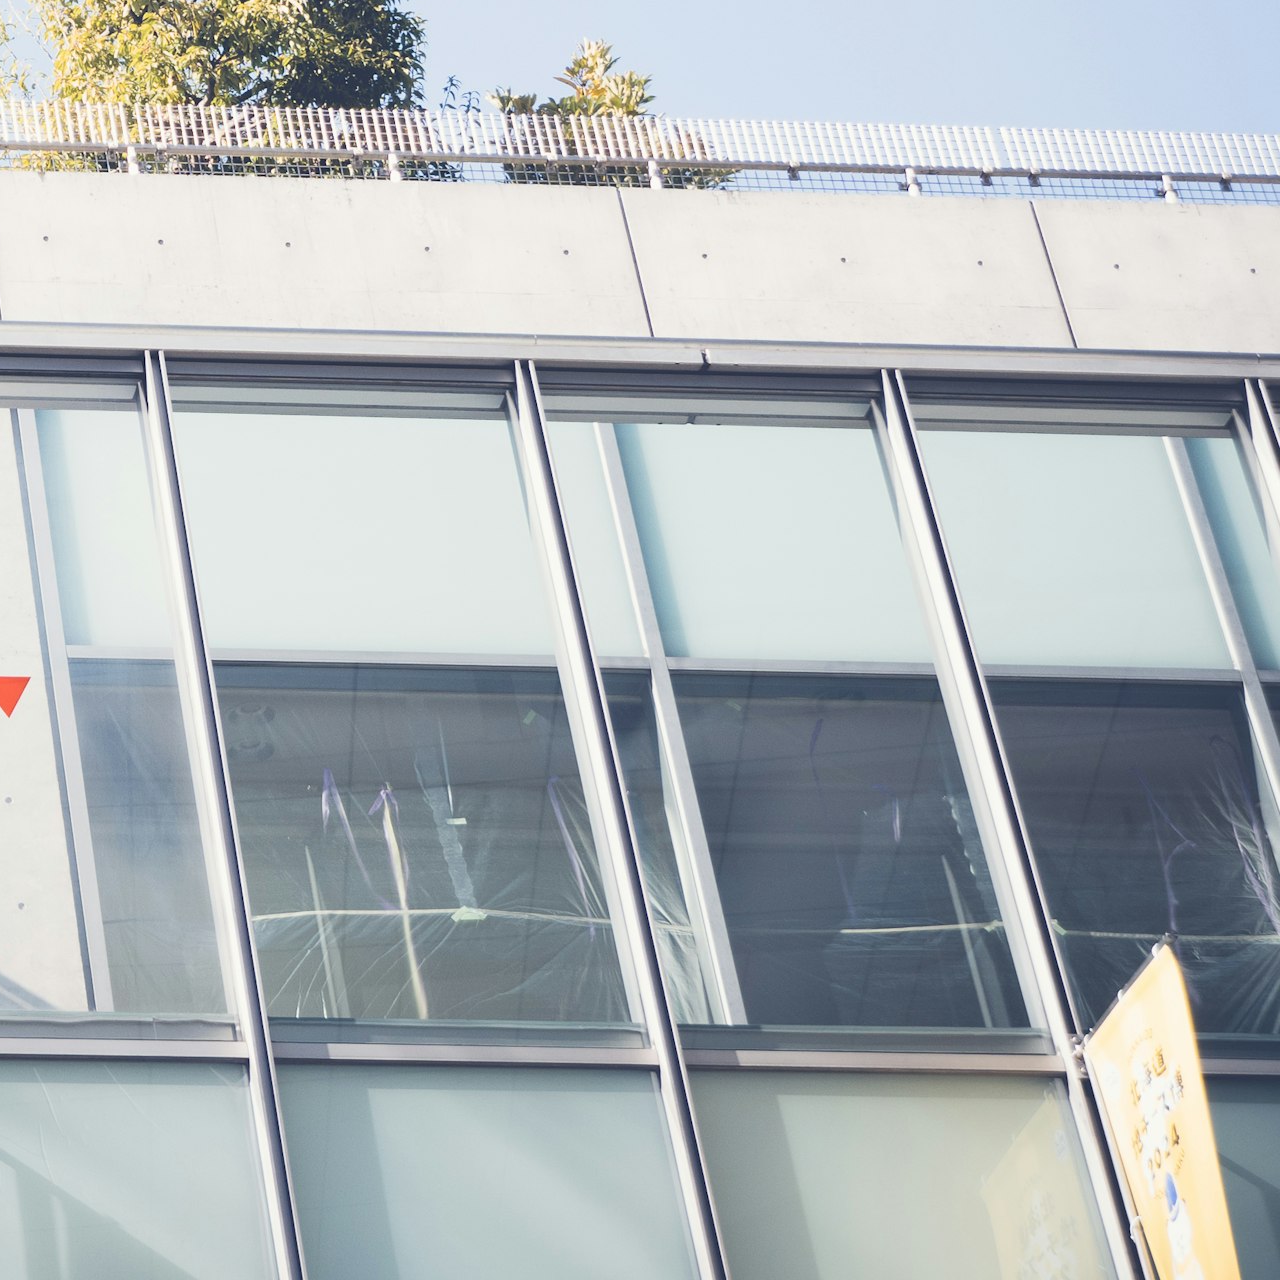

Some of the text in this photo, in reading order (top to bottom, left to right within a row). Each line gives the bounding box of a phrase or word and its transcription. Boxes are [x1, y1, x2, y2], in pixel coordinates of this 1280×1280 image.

[1130, 1045, 1167, 1107] 北海道
[1148, 1123, 1180, 1180] 2024
